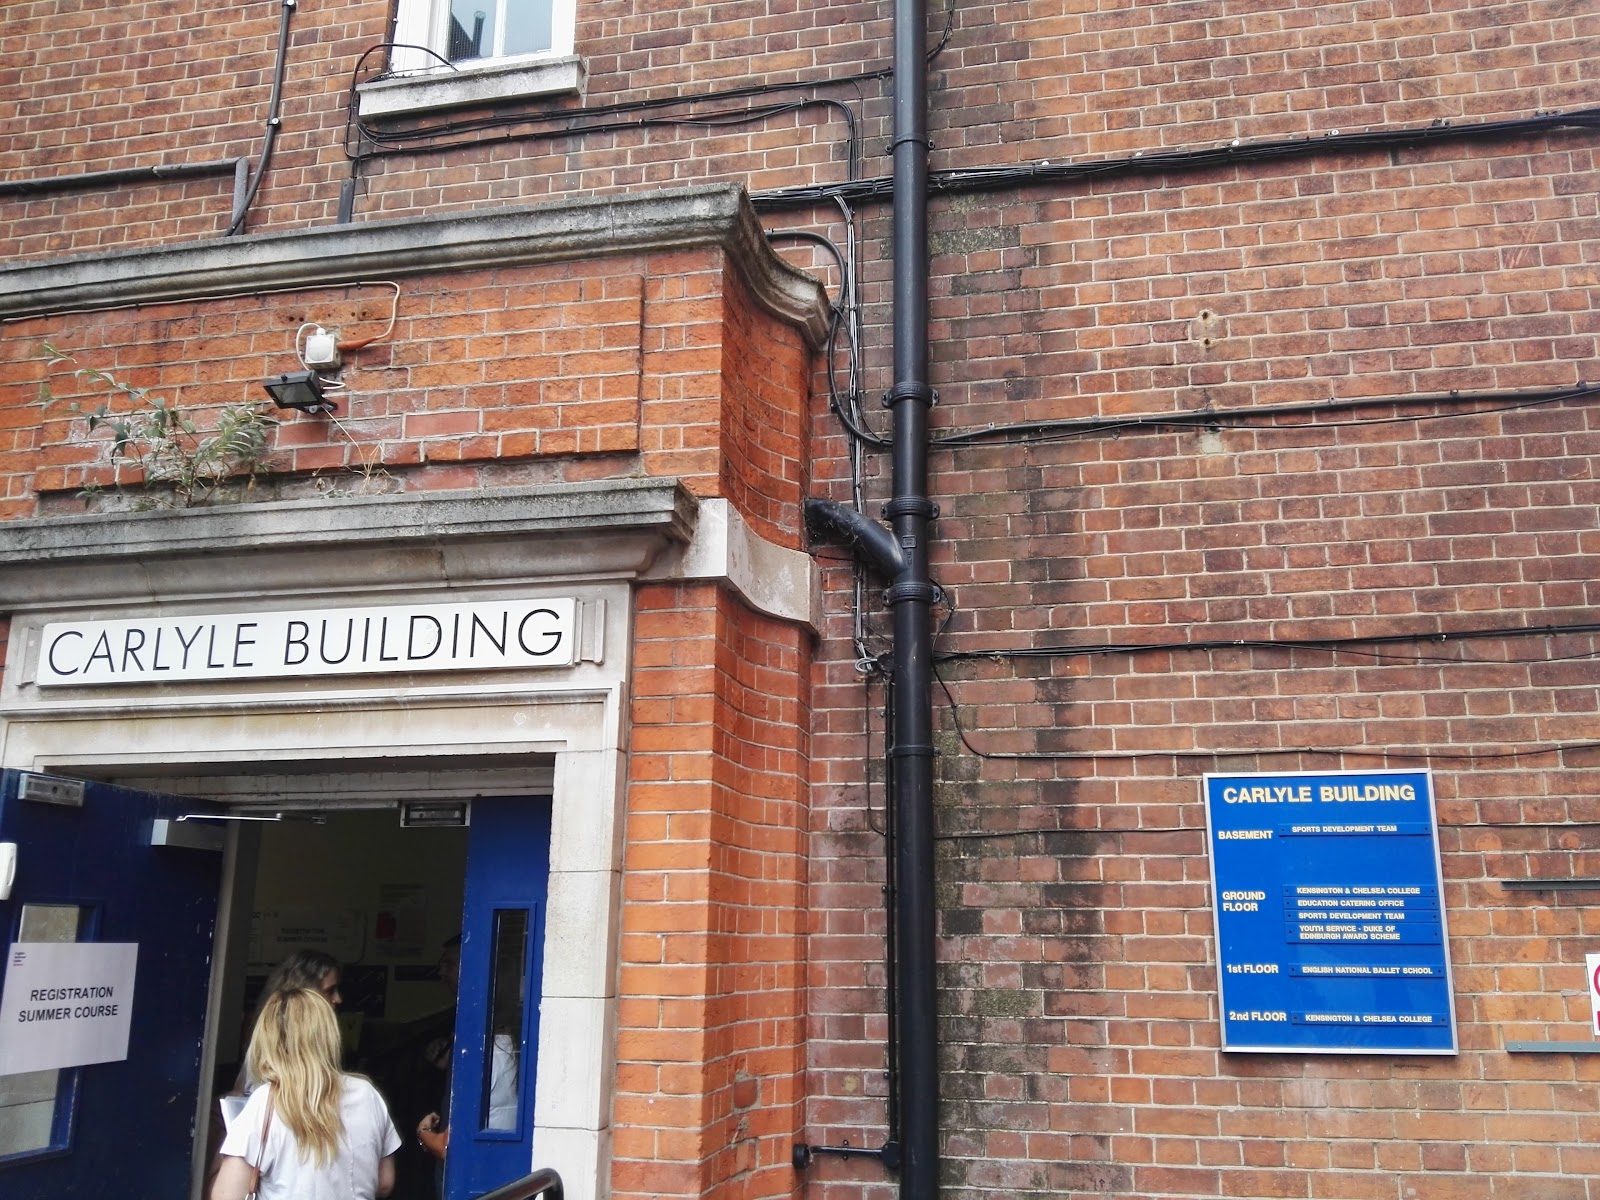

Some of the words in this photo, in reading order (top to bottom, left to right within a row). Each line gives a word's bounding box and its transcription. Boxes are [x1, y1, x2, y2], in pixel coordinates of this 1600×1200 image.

[48, 622, 258, 675] CARLYLE
[283, 608, 562, 665] BUILDING
[1223, 787, 1312, 803] CARLYLE
[1320, 785, 1416, 801] BUILDING
[1218, 830, 1273, 840] BASEMENT
[1222, 892, 1266, 900] GROUND
[1223, 902, 1258, 912] FLOOR
[1226, 964, 1242, 974] 1st
[1244, 964, 1279, 974] FLOOR
[30, 986, 114, 1002] REGISTRATION
[18, 1008, 72, 1022] SUMMER
[74, 1004, 118, 1018] COURSE
[1230, 1012, 1249, 1022] 2nd
[1252, 1012, 1287, 1022] FLOOR
